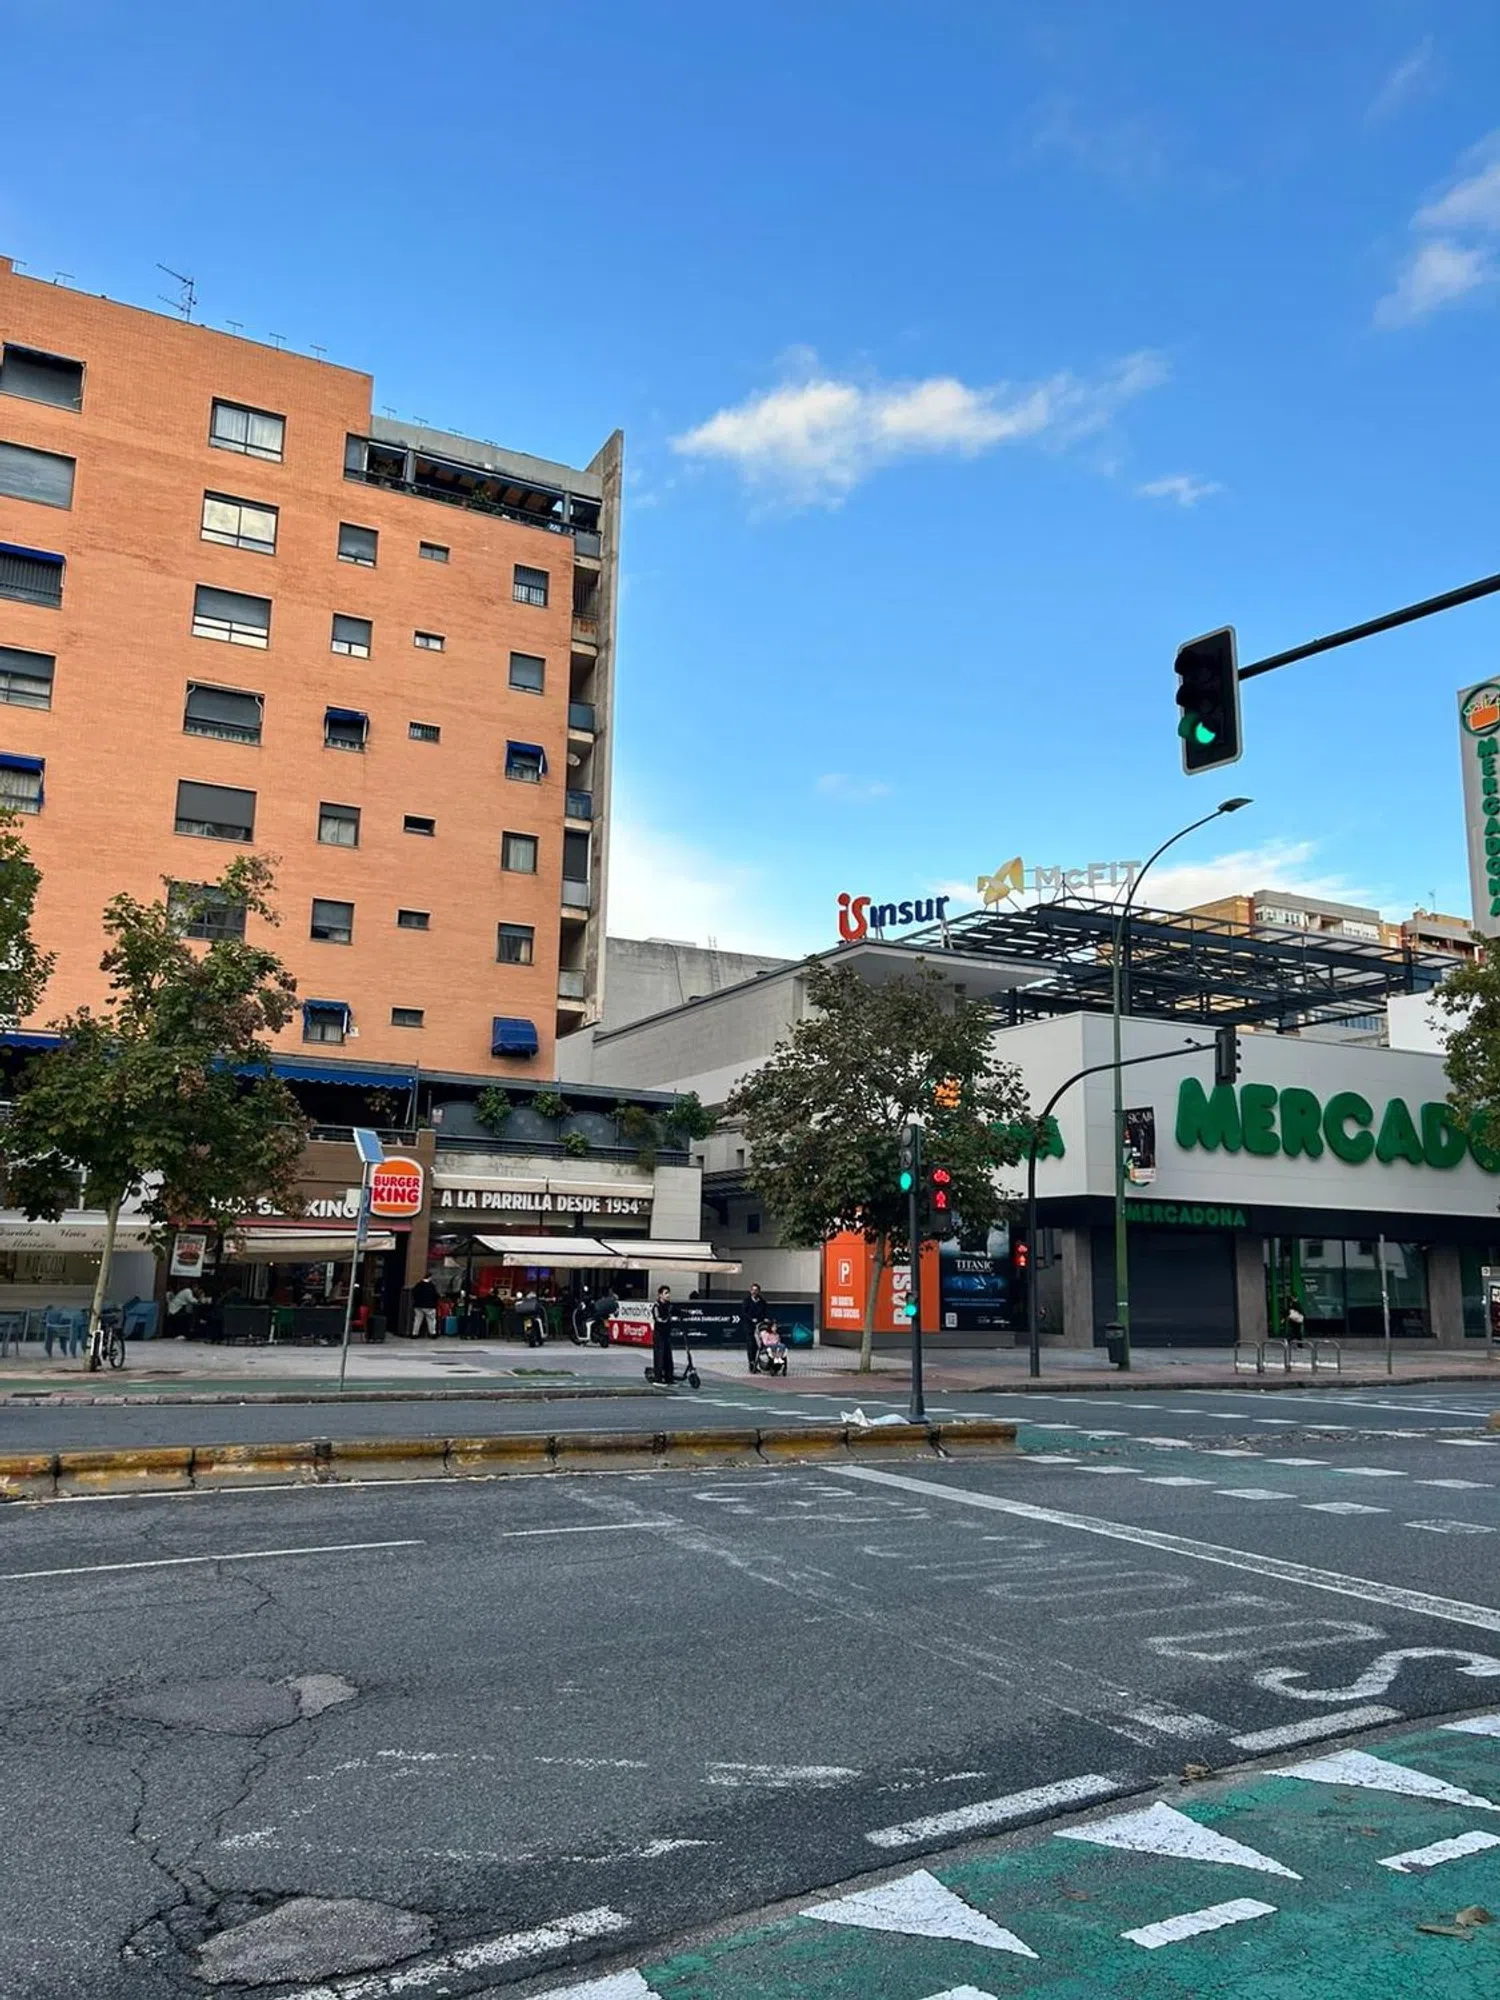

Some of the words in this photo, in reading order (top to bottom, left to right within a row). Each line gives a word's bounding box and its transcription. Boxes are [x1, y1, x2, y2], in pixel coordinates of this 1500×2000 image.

[1035, 860, 1142, 891] McFIT
[374, 1175, 420, 1188] BURGER
[374, 1188, 419, 1204] KING
[441, 1190, 452, 1207] A
[457, 1190, 477, 1208] LA
[481, 1191, 552, 1211] PARRILLA
[557, 1195, 601, 1213] DESDE
[306, 1199, 358, 1219] KING
[1124, 1203, 1247, 1227] MERCADONA
[841, 1262, 850, 1283] P
[955, 1259, 994, 1270] TITANIC
